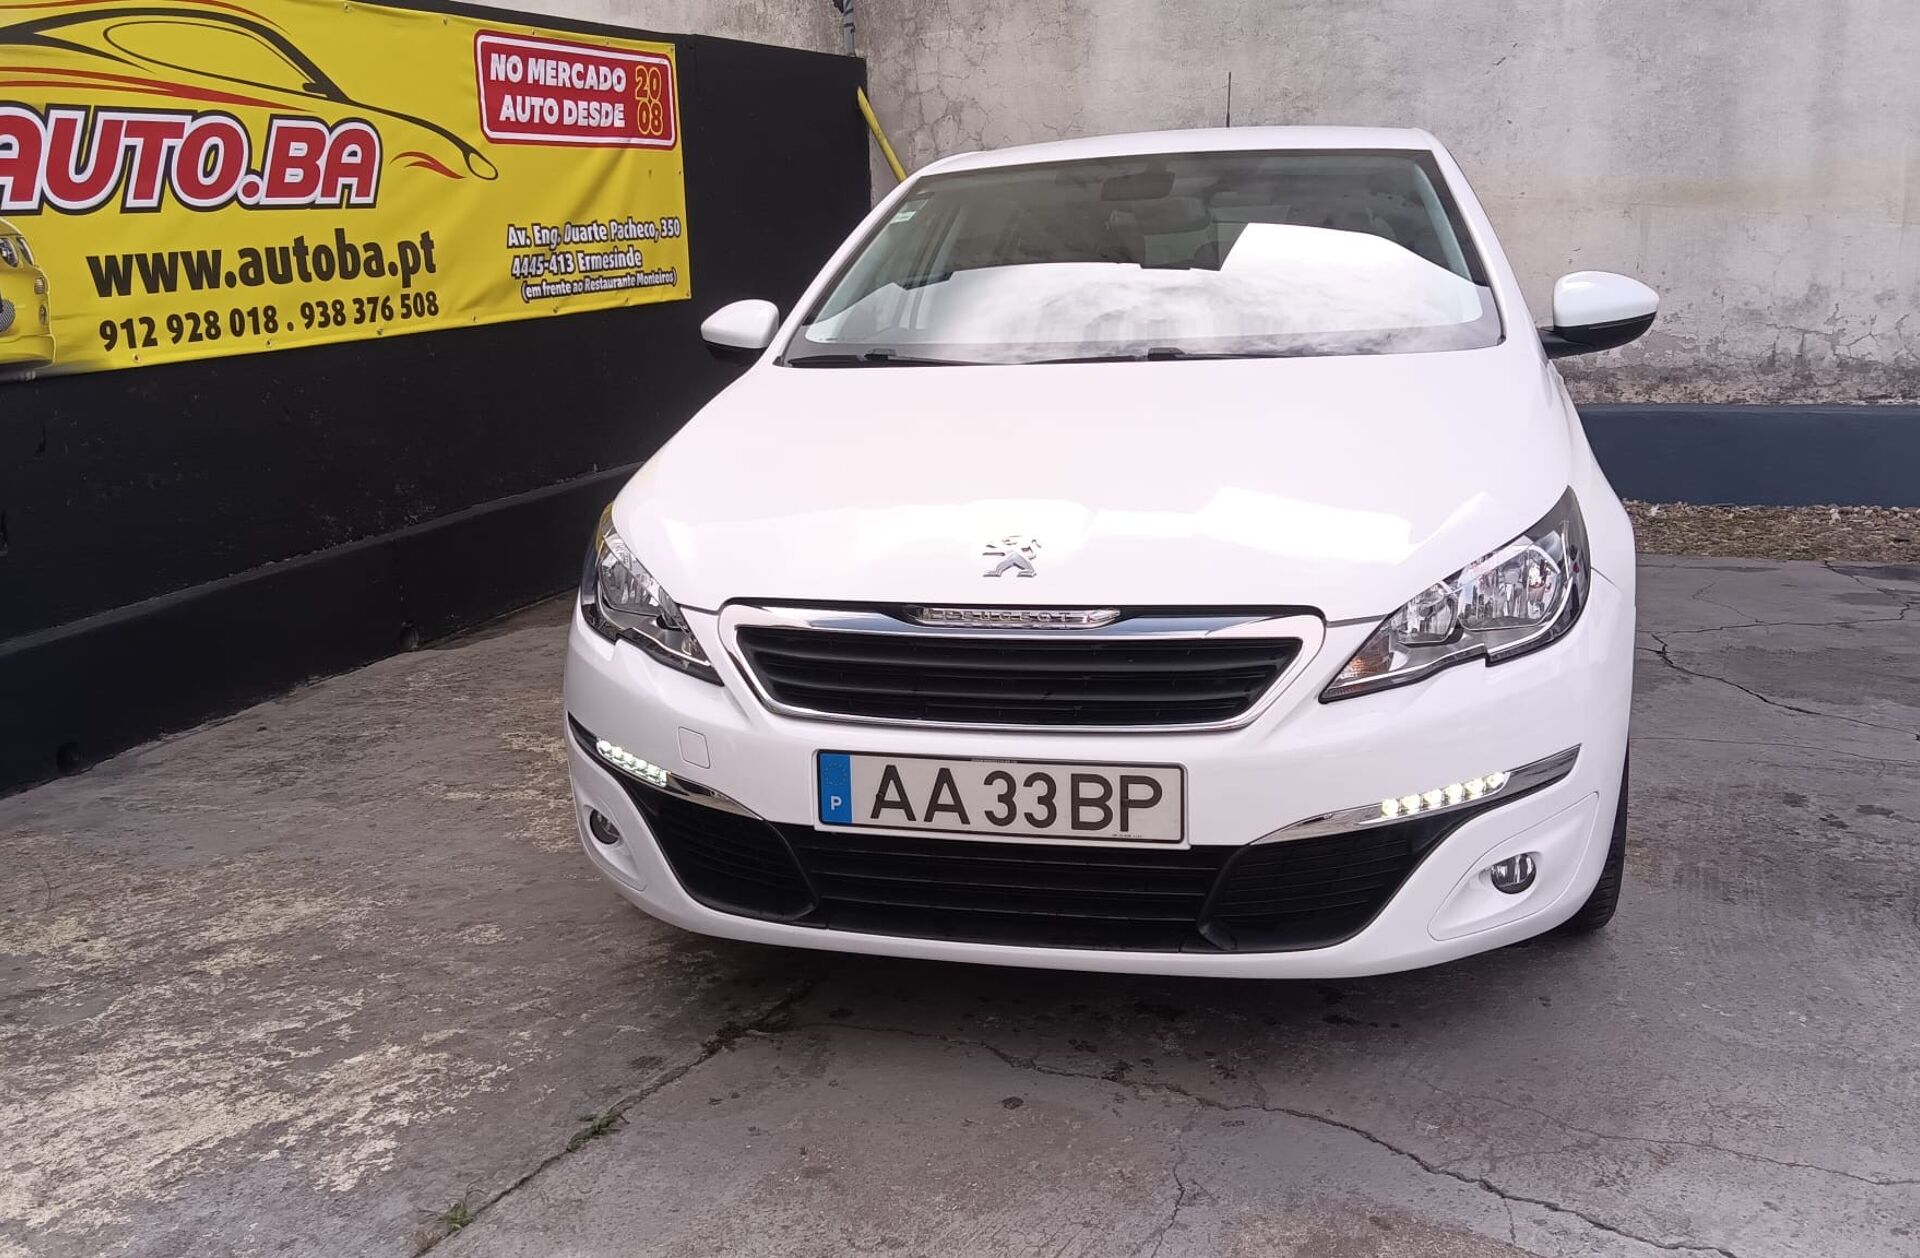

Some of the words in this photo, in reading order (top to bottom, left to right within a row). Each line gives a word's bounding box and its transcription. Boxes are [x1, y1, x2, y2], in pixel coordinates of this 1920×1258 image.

[490, 53, 523, 83] NO
[527, 58, 627, 93] MERCADO
[635, 65, 662, 101] 20
[499, 94, 559, 125] AUTO
[563, 99, 626, 128] DESDE
[637, 101, 663, 136] 08
[507, 223, 532, 248] Av.
[531, 223, 561, 250] Eng.
[563, 220, 608, 244] Duarte
[610, 216, 660, 242] Pacheco,
[661, 216, 681, 238] 350
[86, 228, 436, 298] www.autoba.pt
[511, 251, 575, 279] 4445-413
[577, 245, 643, 272] Ermesinde
[521, 279, 543, 303] (em
[542, 277, 573, 296] frente
[572, 279, 584, 294] ao
[583, 273, 637, 290] Restaurante
[99, 317, 158, 352] 912
[166, 310, 222, 344] 928
[229, 305, 279, 337] 018
[300, 299, 346, 330] 938
[353, 295, 394, 325] 376
[400, 291, 440, 320] 508
[830, 795, 842, 811] P
[869, 764, 971, 826] AA
[983, 770, 1058, 828] 33
[1070, 773, 1164, 833] BP
